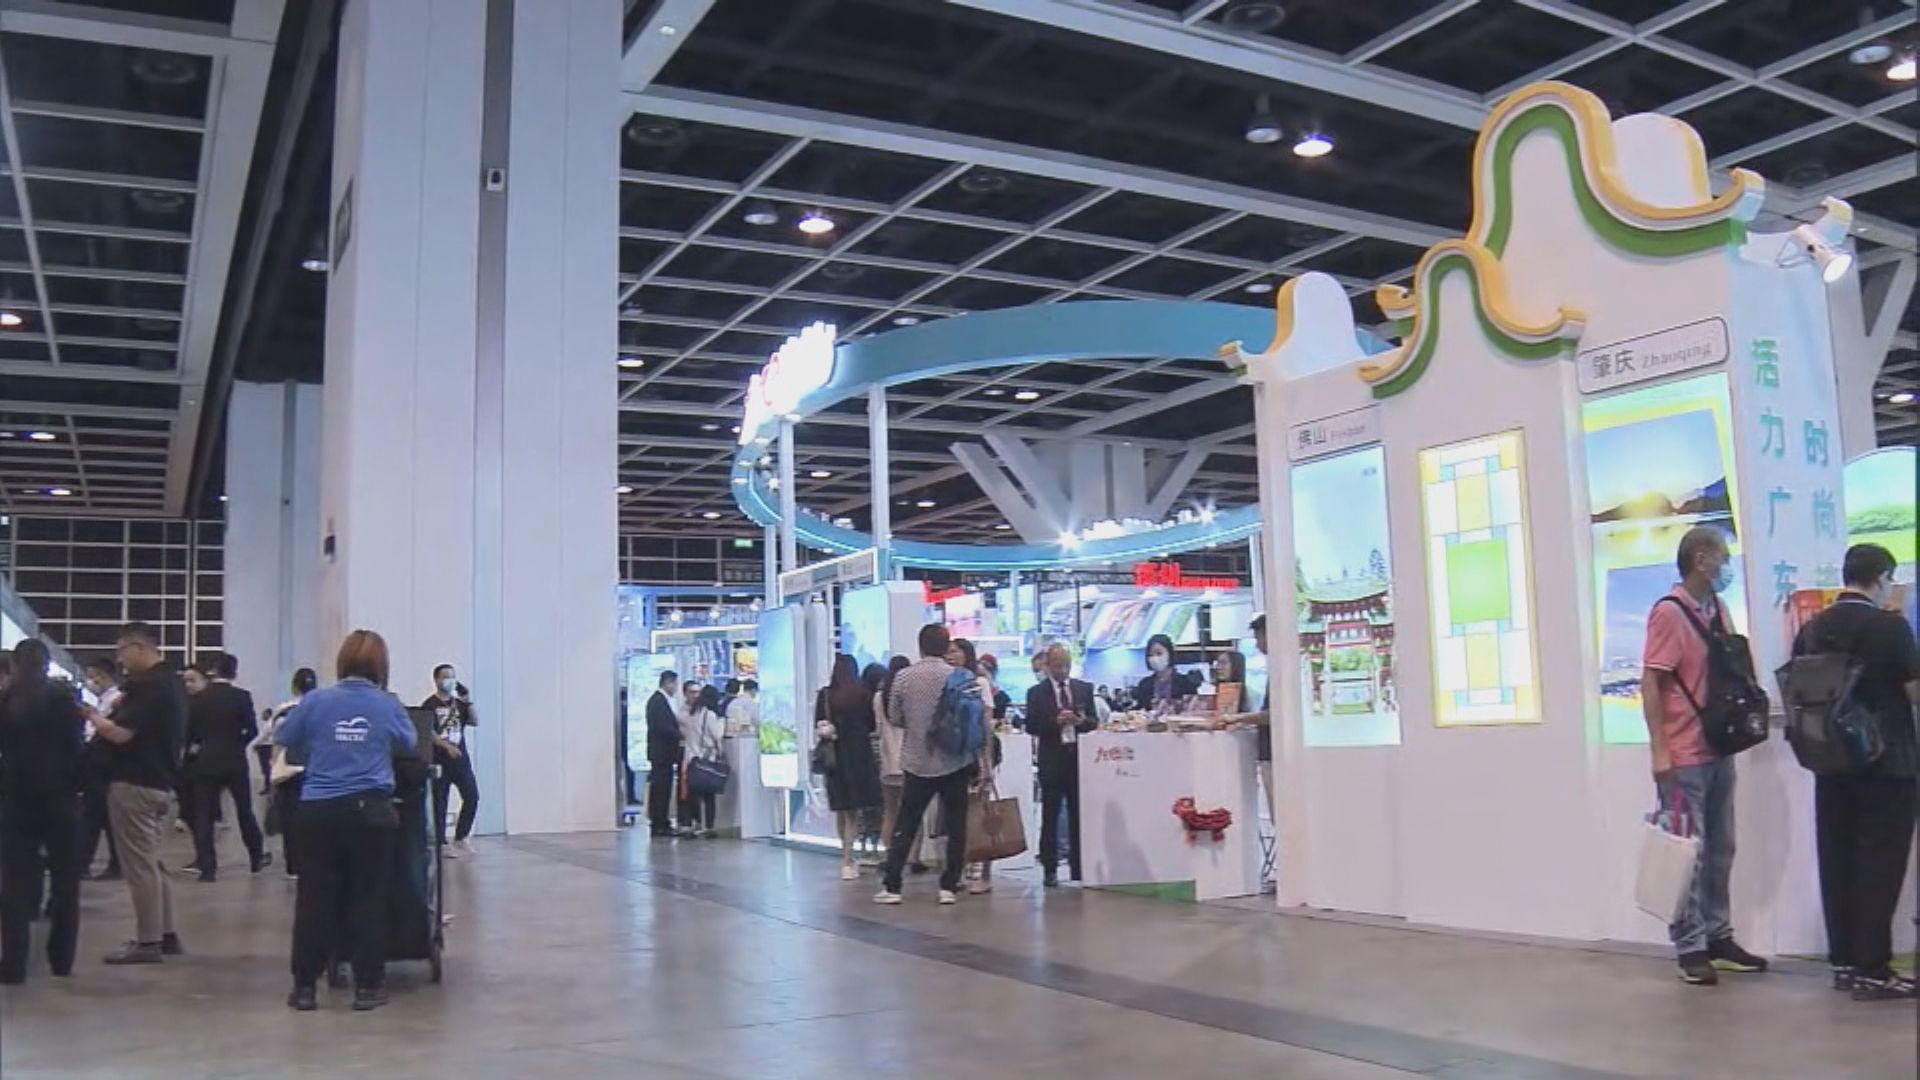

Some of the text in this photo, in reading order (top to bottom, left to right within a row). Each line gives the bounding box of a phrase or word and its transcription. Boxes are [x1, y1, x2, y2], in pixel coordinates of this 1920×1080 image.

[1593, 350, 1636, 379] 肇庆
[1752, 339, 1798, 613] 活力广东
